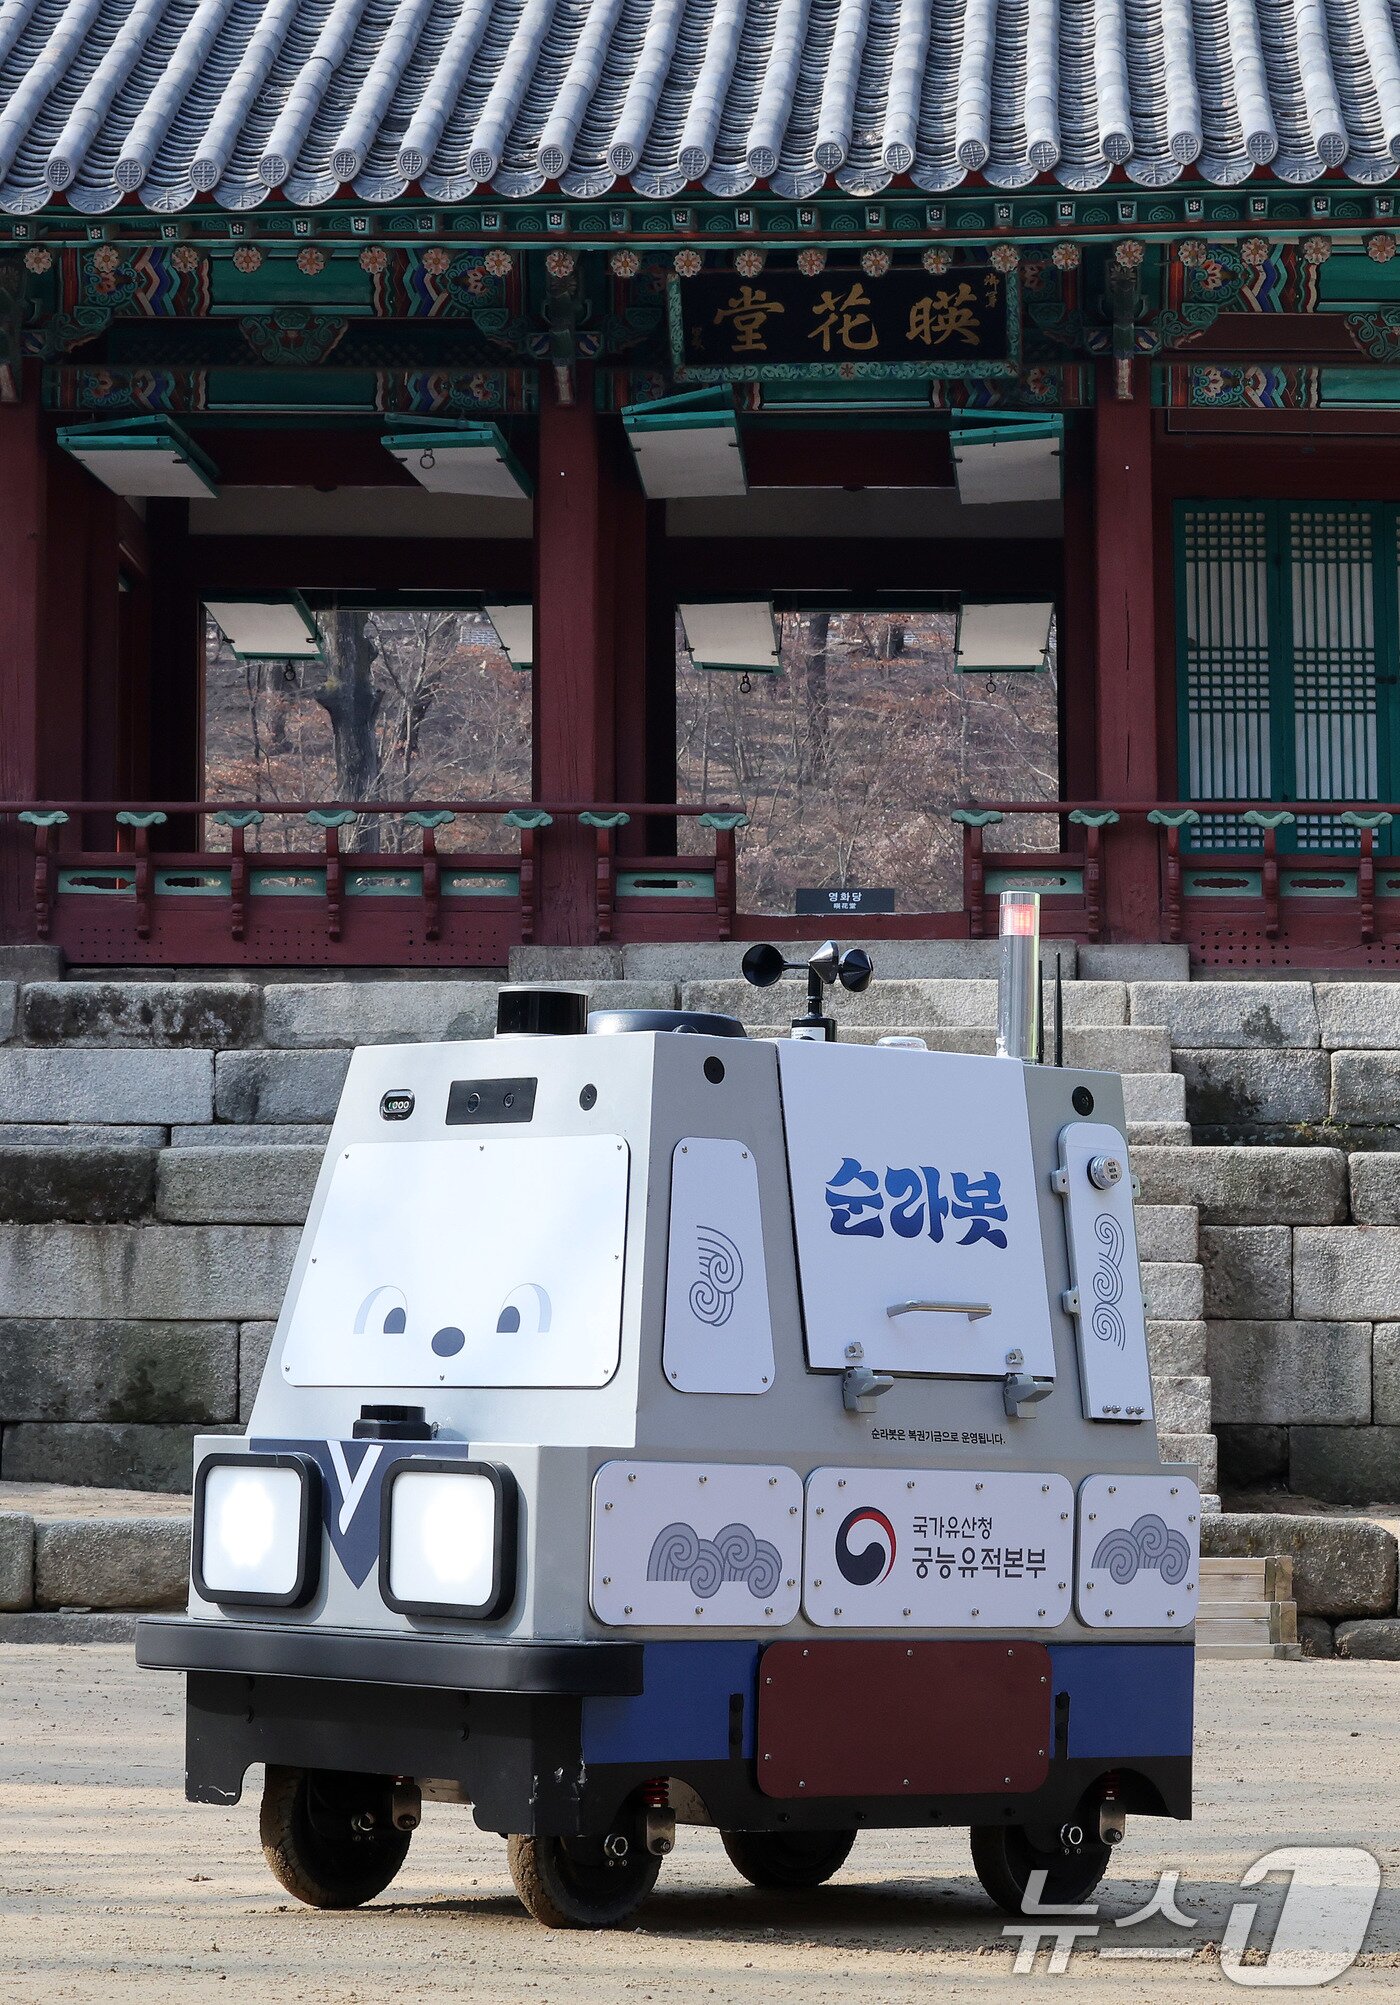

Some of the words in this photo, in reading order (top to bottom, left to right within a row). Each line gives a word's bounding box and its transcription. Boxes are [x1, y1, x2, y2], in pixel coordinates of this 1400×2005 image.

[828, 892, 862, 902] 영화당
[825, 1157, 1008, 1249] 순라봇
[871, 1428, 906, 1441] 순라봇은
[908, 1430, 960, 1443] 복권기금으로
[961, 1431, 1006, 1445] 운영됩니다.
[912, 1516, 993, 1540] 국가유산청
[912, 1546, 1047, 1579] 궁능유적본부
